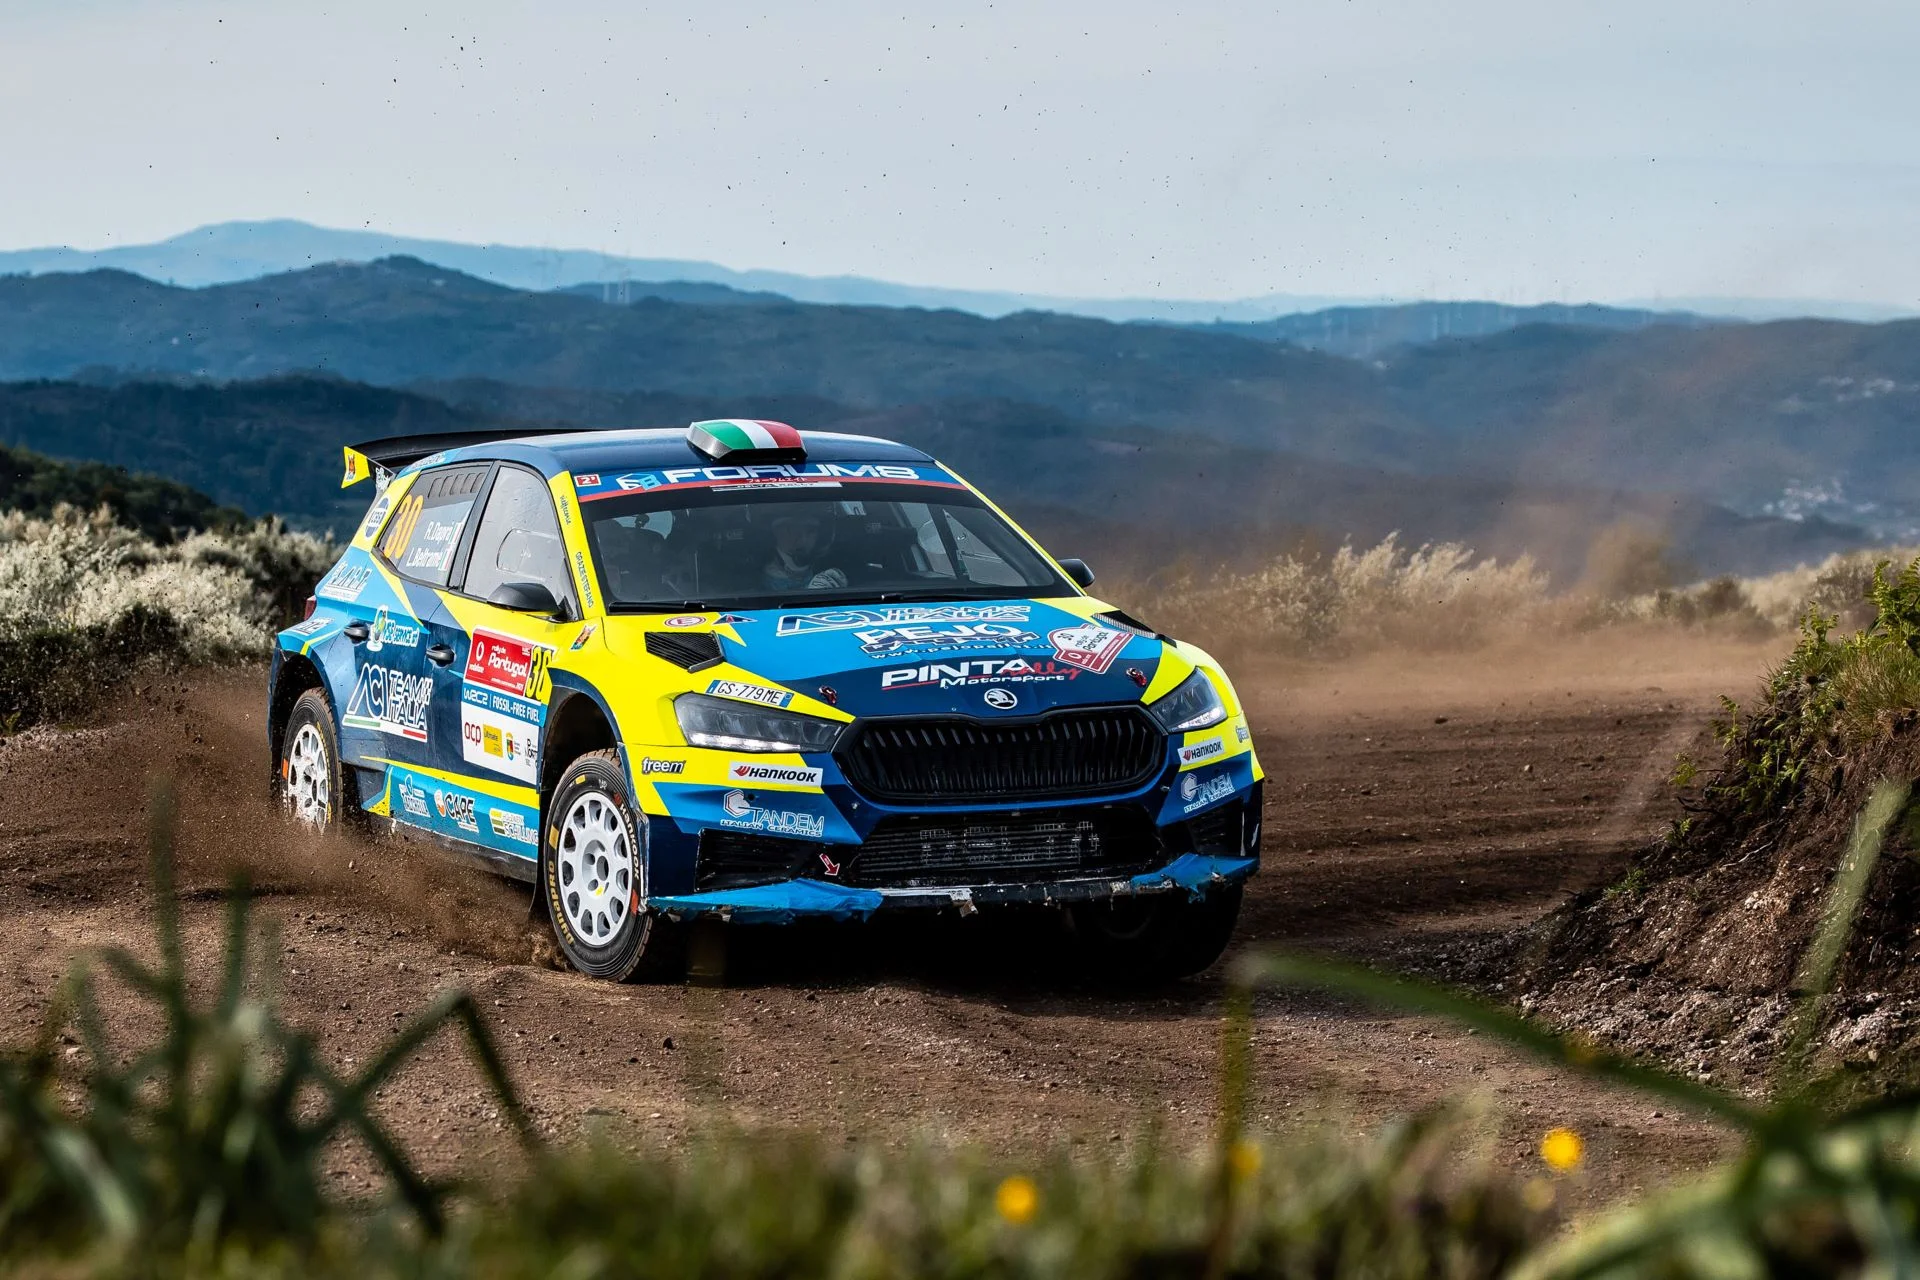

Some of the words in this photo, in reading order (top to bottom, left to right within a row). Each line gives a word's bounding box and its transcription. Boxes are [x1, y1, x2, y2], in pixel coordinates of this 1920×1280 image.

[662, 464, 920, 485] FORUM8
[383, 494, 424, 560] 30
[853, 623, 1023, 645] PEJO
[488, 652, 529, 678] Portugal
[881, 658, 1036, 687] PINTA
[346, 662, 391, 721] ACI
[389, 669, 426, 705] TEAM
[939, 674, 1065, 688] Motorsport
[390, 696, 428, 731] ITALIA
[493, 695, 526, 719] FOSSIL-FREE
[526, 707, 540, 723] FUEL
[464, 721, 481, 746] acp
[641, 757, 687, 775] freem
[444, 792, 476, 824] CAPE
[750, 808, 825, 831] TANDEM
[720, 819, 763, 830] ITALIAN
[767, 825, 823, 837] CERAMICS
